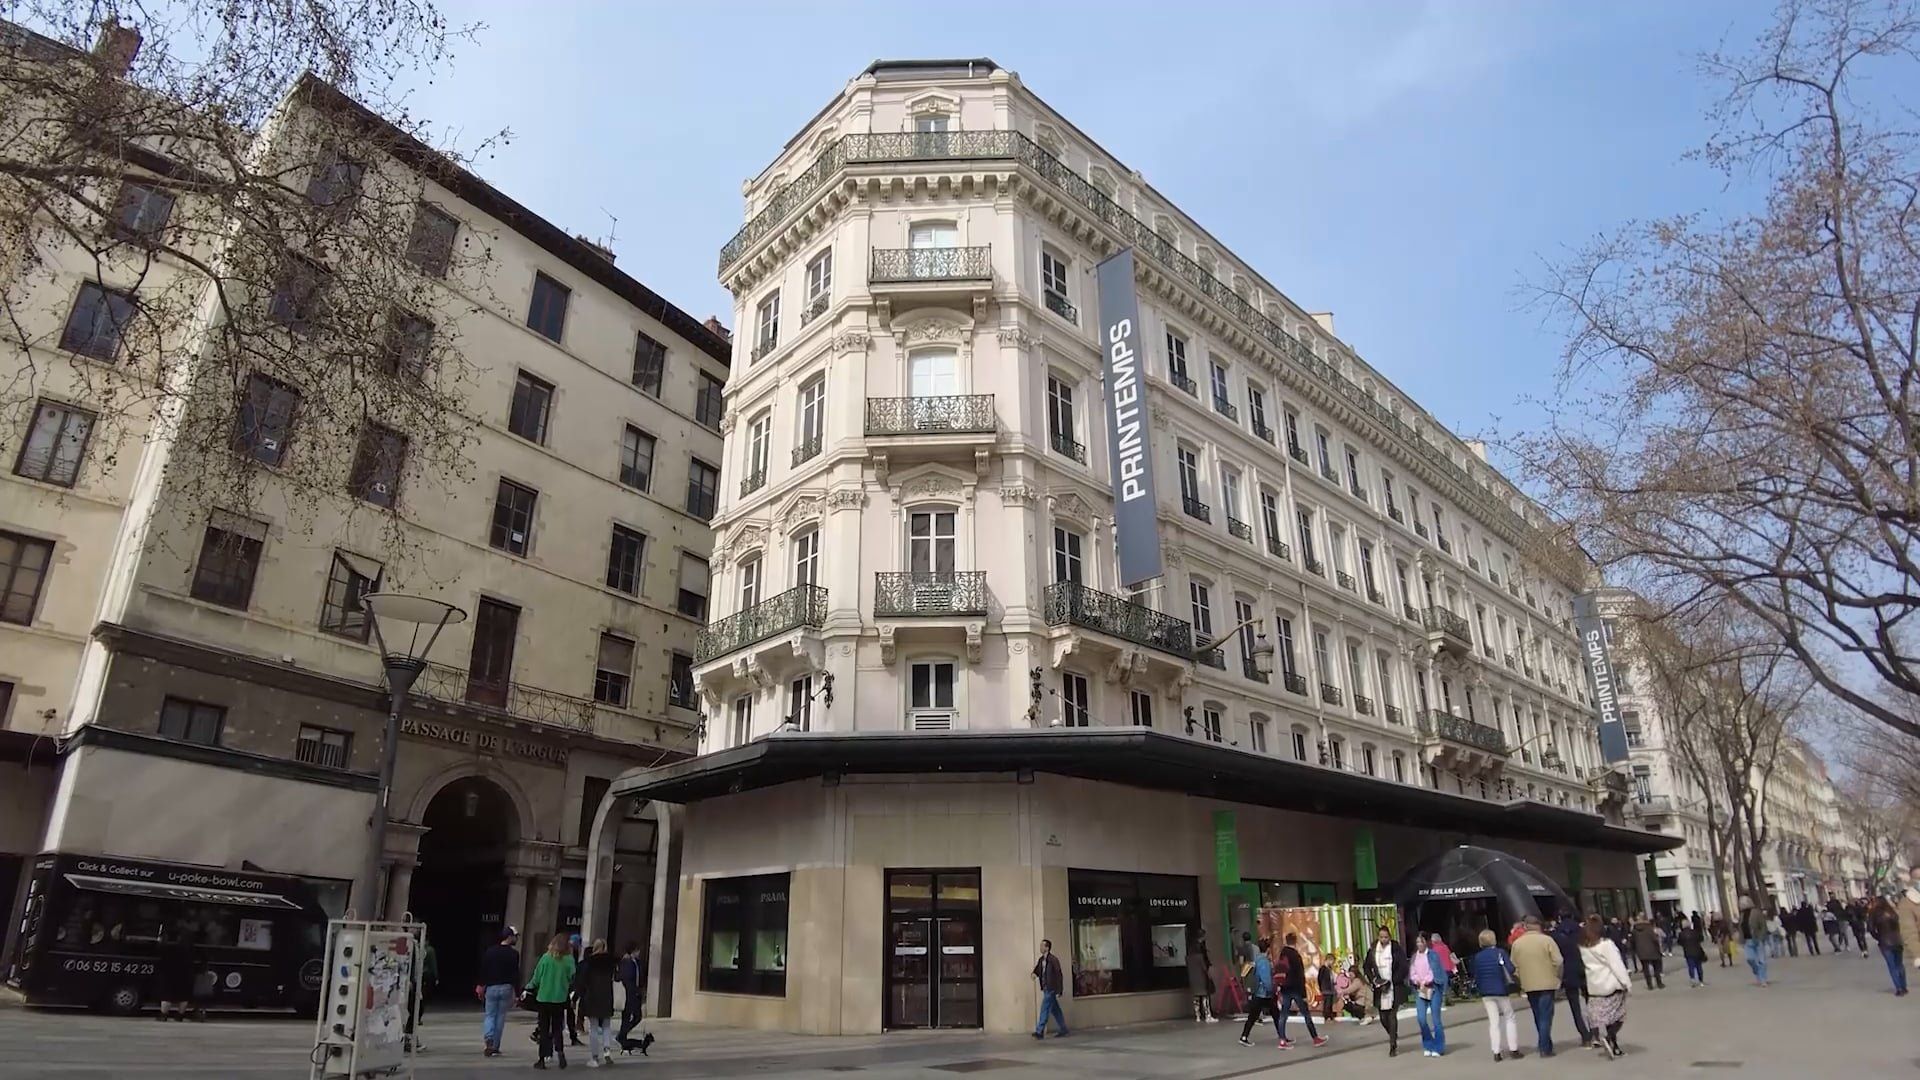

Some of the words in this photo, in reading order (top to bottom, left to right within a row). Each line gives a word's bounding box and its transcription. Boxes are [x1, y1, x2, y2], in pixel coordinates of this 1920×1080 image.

[1109, 318, 1146, 502] PRINTEMPS
[1586, 629, 1617, 723] PRINTEMPS
[400, 719, 472, 745] PASSAGE
[478, 733, 498, 749] DE
[78, 861, 98, 872] Click
[100, 864, 107, 872] &
[109, 864, 139, 876] Collect
[140, 869, 154, 877] sur
[168, 873, 263, 890] u-poke-bowl.com
[1078, 897, 1122, 905] LONGCHAMP
[1430, 887, 1453, 895] SELLE
[1454, 886, 1485, 894] MARCEL
[1149, 899, 1188, 907] LONGCHAMP
[76, 961, 91, 971] 06
[93, 961, 108, 972] 52
[110, 962, 121, 972] 15
[124, 963, 139, 974] 42
[141, 964, 154, 974] 23
